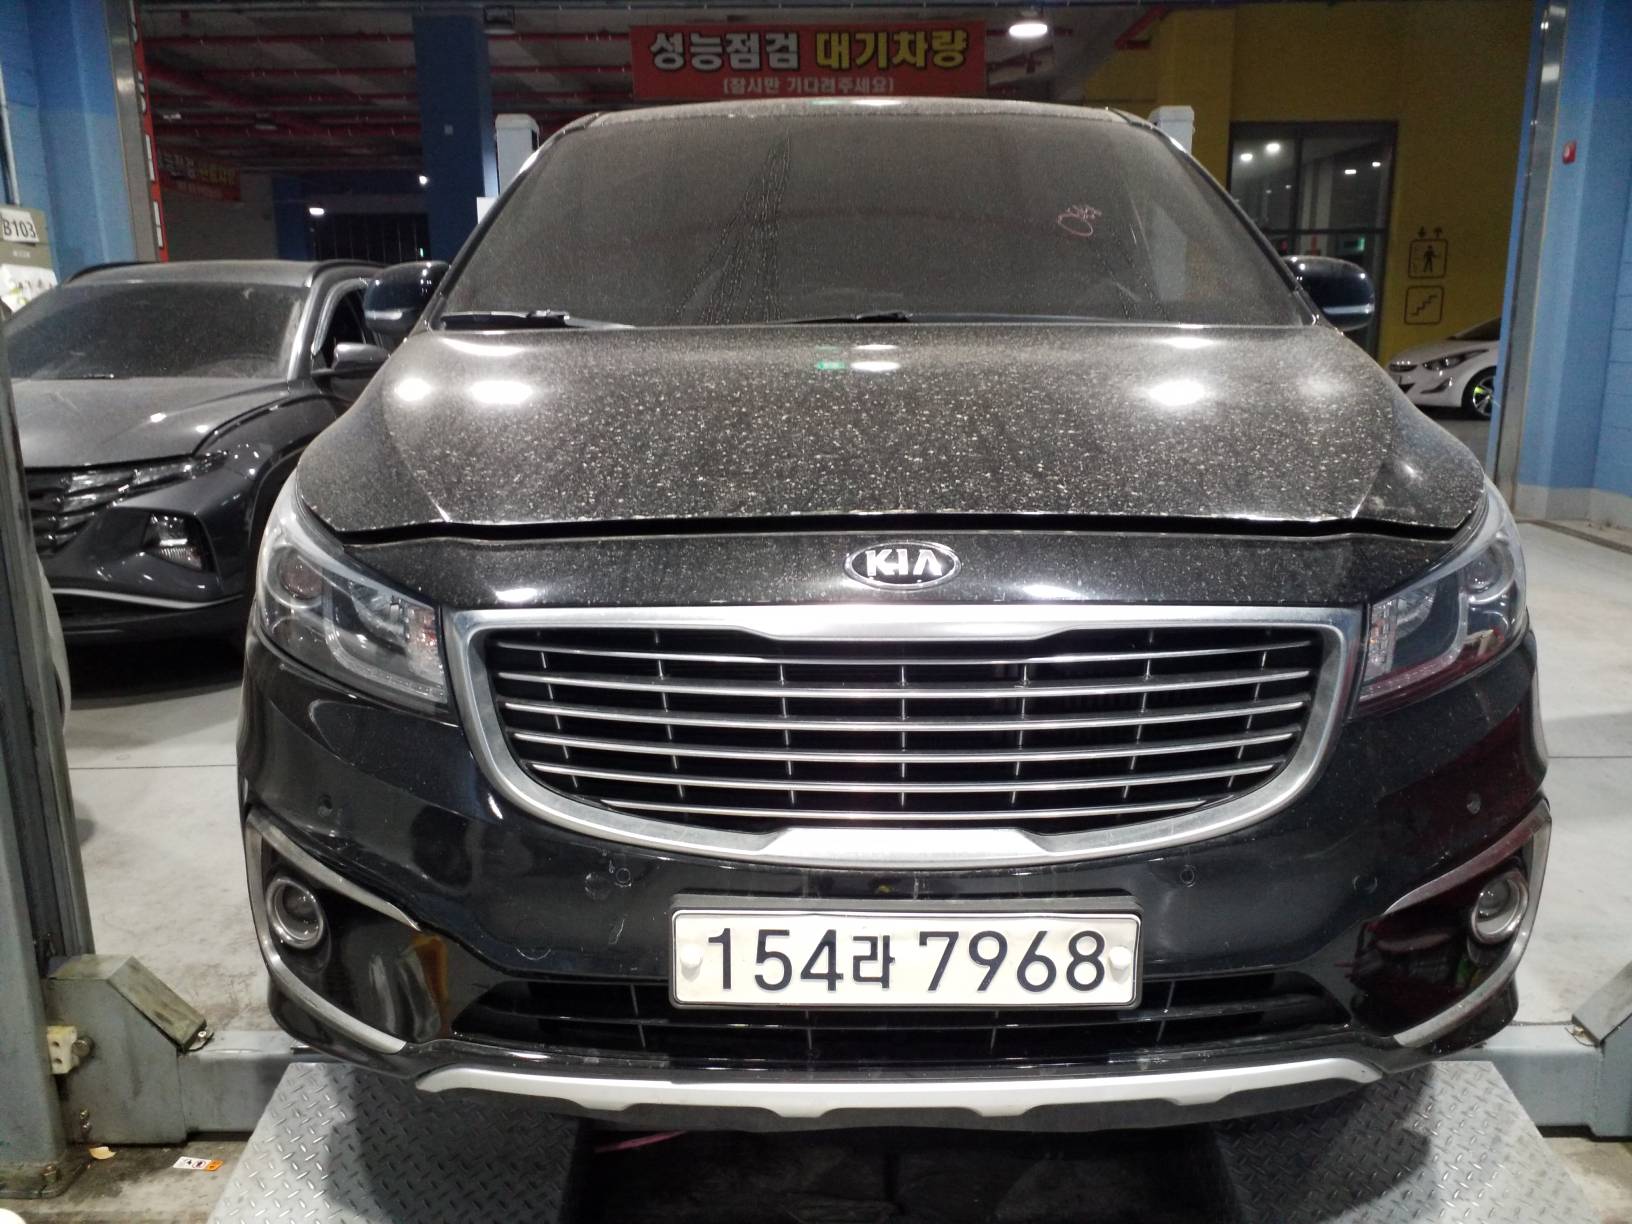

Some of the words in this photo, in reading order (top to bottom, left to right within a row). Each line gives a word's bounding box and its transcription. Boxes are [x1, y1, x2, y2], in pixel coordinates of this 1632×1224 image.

[650, 30, 800, 71] 성능점검
[815, 29, 968, 69] 대기차량
[3, 219, 36, 238] B103
[865, 548, 943, 576] KIA
[707, 927, 896, 992] 154라
[918, 930, 1106, 992] 7968
